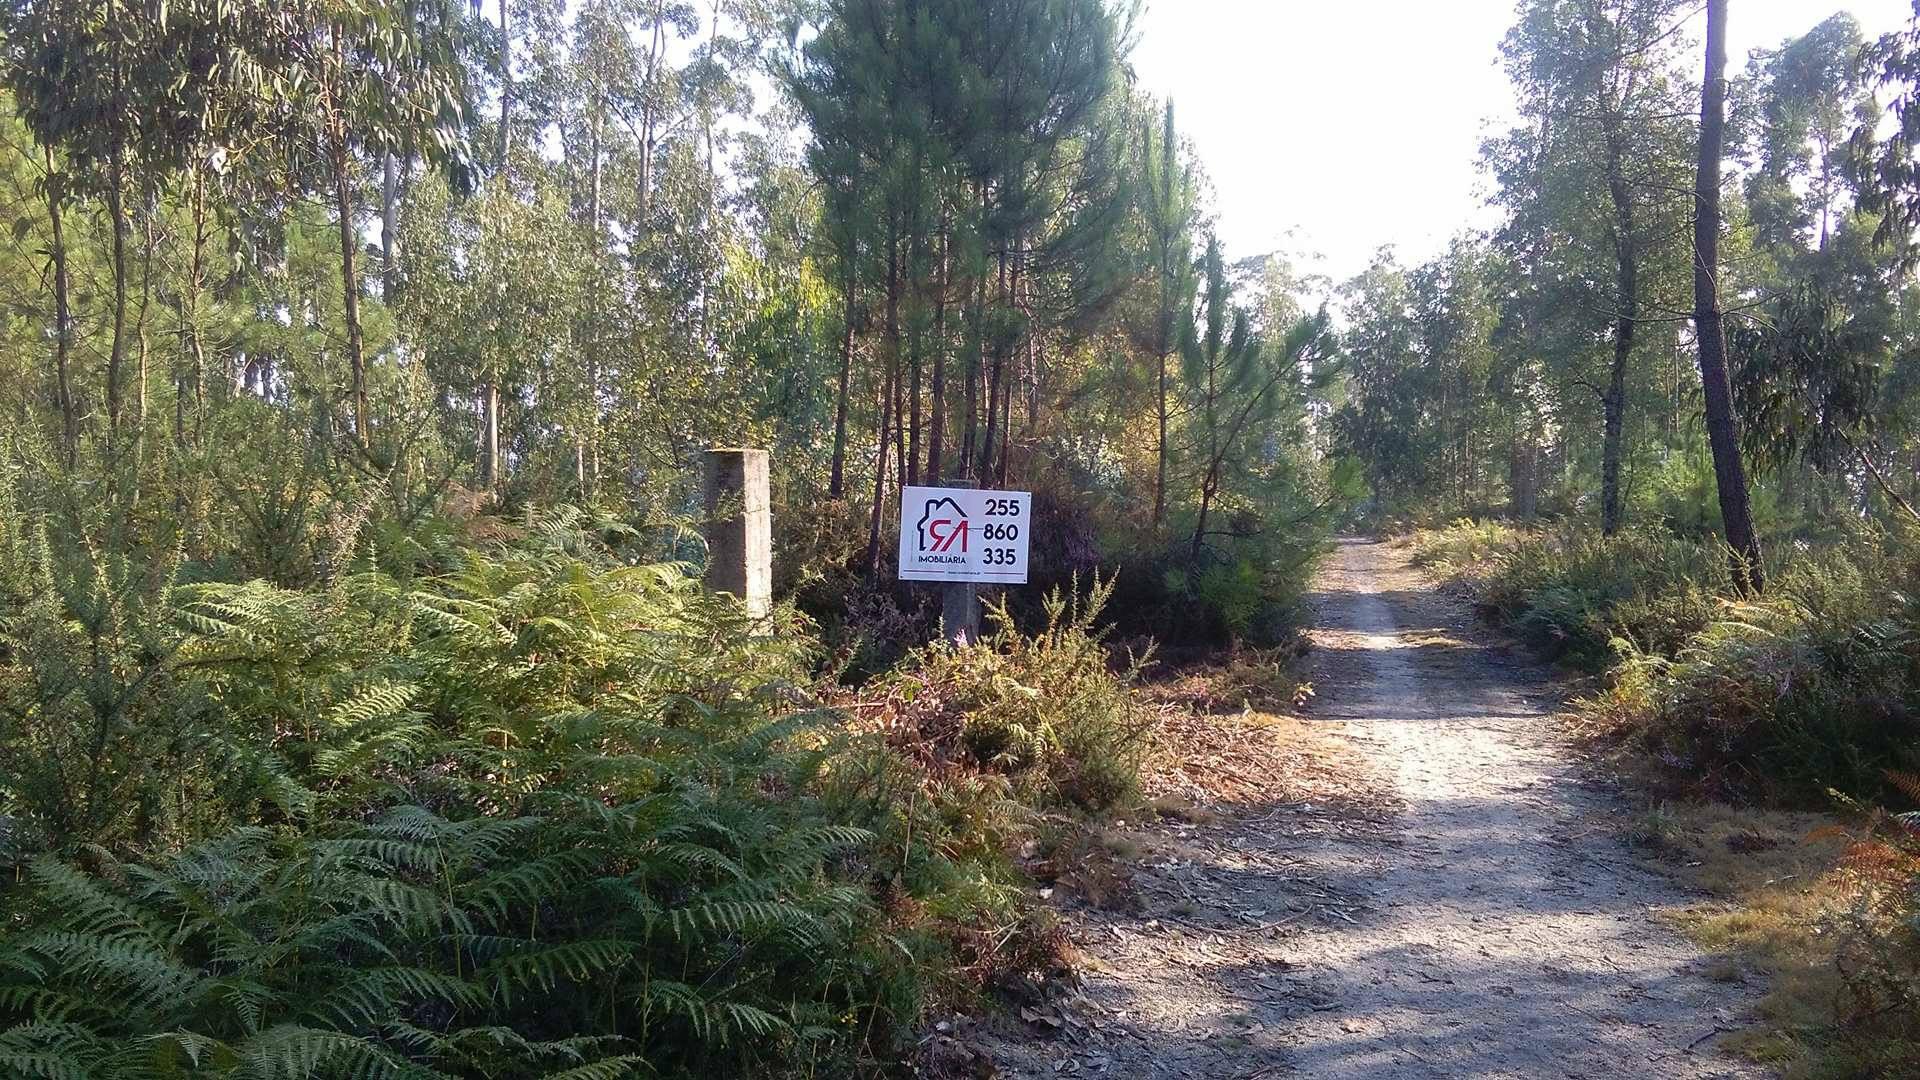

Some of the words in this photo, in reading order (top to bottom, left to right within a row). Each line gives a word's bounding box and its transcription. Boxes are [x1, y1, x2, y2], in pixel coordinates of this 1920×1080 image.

[985, 498, 1020, 516] 255
[983, 523, 1019, 541] 860
[982, 547, 1017, 565] 335
